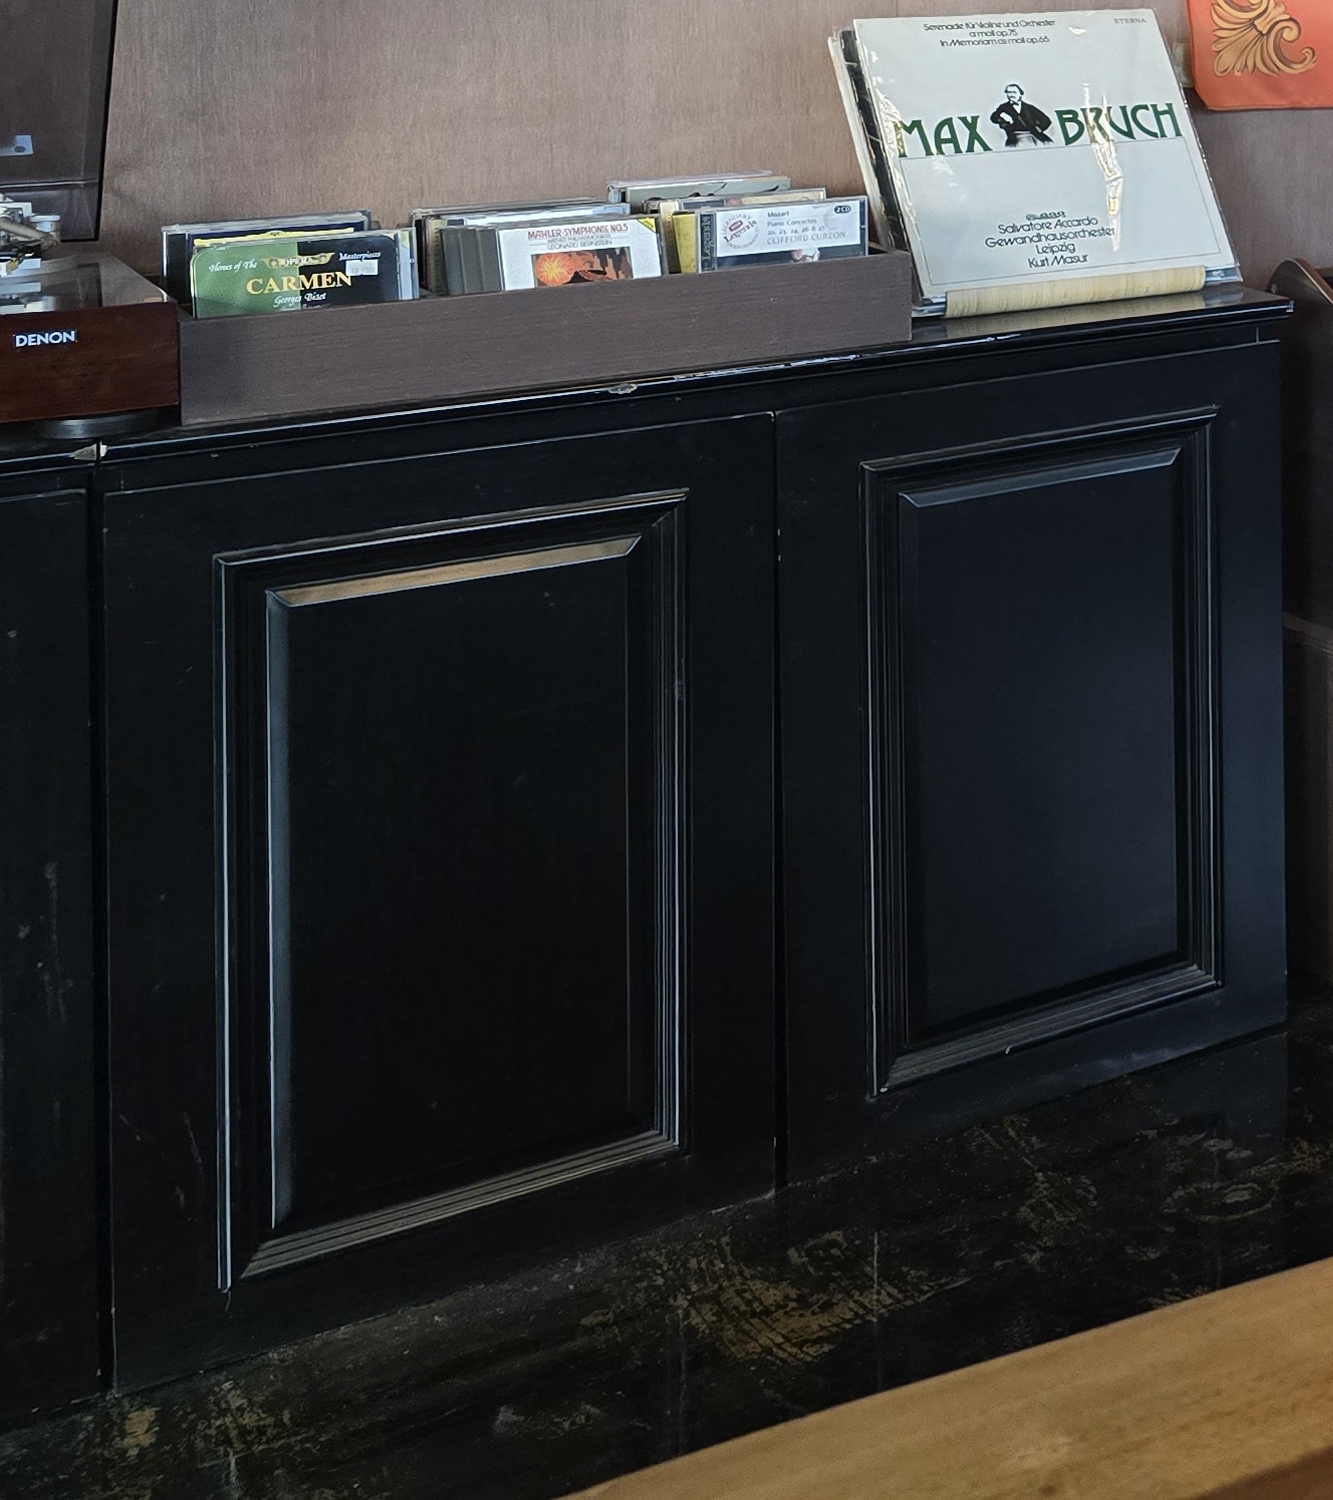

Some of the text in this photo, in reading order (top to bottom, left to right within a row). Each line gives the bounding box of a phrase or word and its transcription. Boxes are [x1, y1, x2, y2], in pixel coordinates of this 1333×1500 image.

[923, 22, 964, 31] Serenade
[1003, 20, 1019, 28] und
[1019, 19, 1055, 28] Orchester
[977, 29, 995, 37] moll
[950, 38, 997, 47] Memoriam
[898, 102, 1183, 158] MAX BRUCH
[767, 210, 789, 218] Mozart
[998, 216, 1099, 235] Salvatore Accardo
[767, 231, 846, 245] CLIFFORD CURZON
[985, 226, 1115, 248] Gewandhausorchester
[1035, 242, 1076, 255] Leipzig
[208, 262, 232, 272] Heroes
[233, 261, 241, 273] of
[242, 258, 258, 270] The
[1028, 254, 1089, 268] Kurt Masur
[246, 271, 352, 295] CARMEN
[273, 294, 302, 308] Georges
[304, 291, 326, 302] Bizet
[15, 329, 77, 348] DENON
